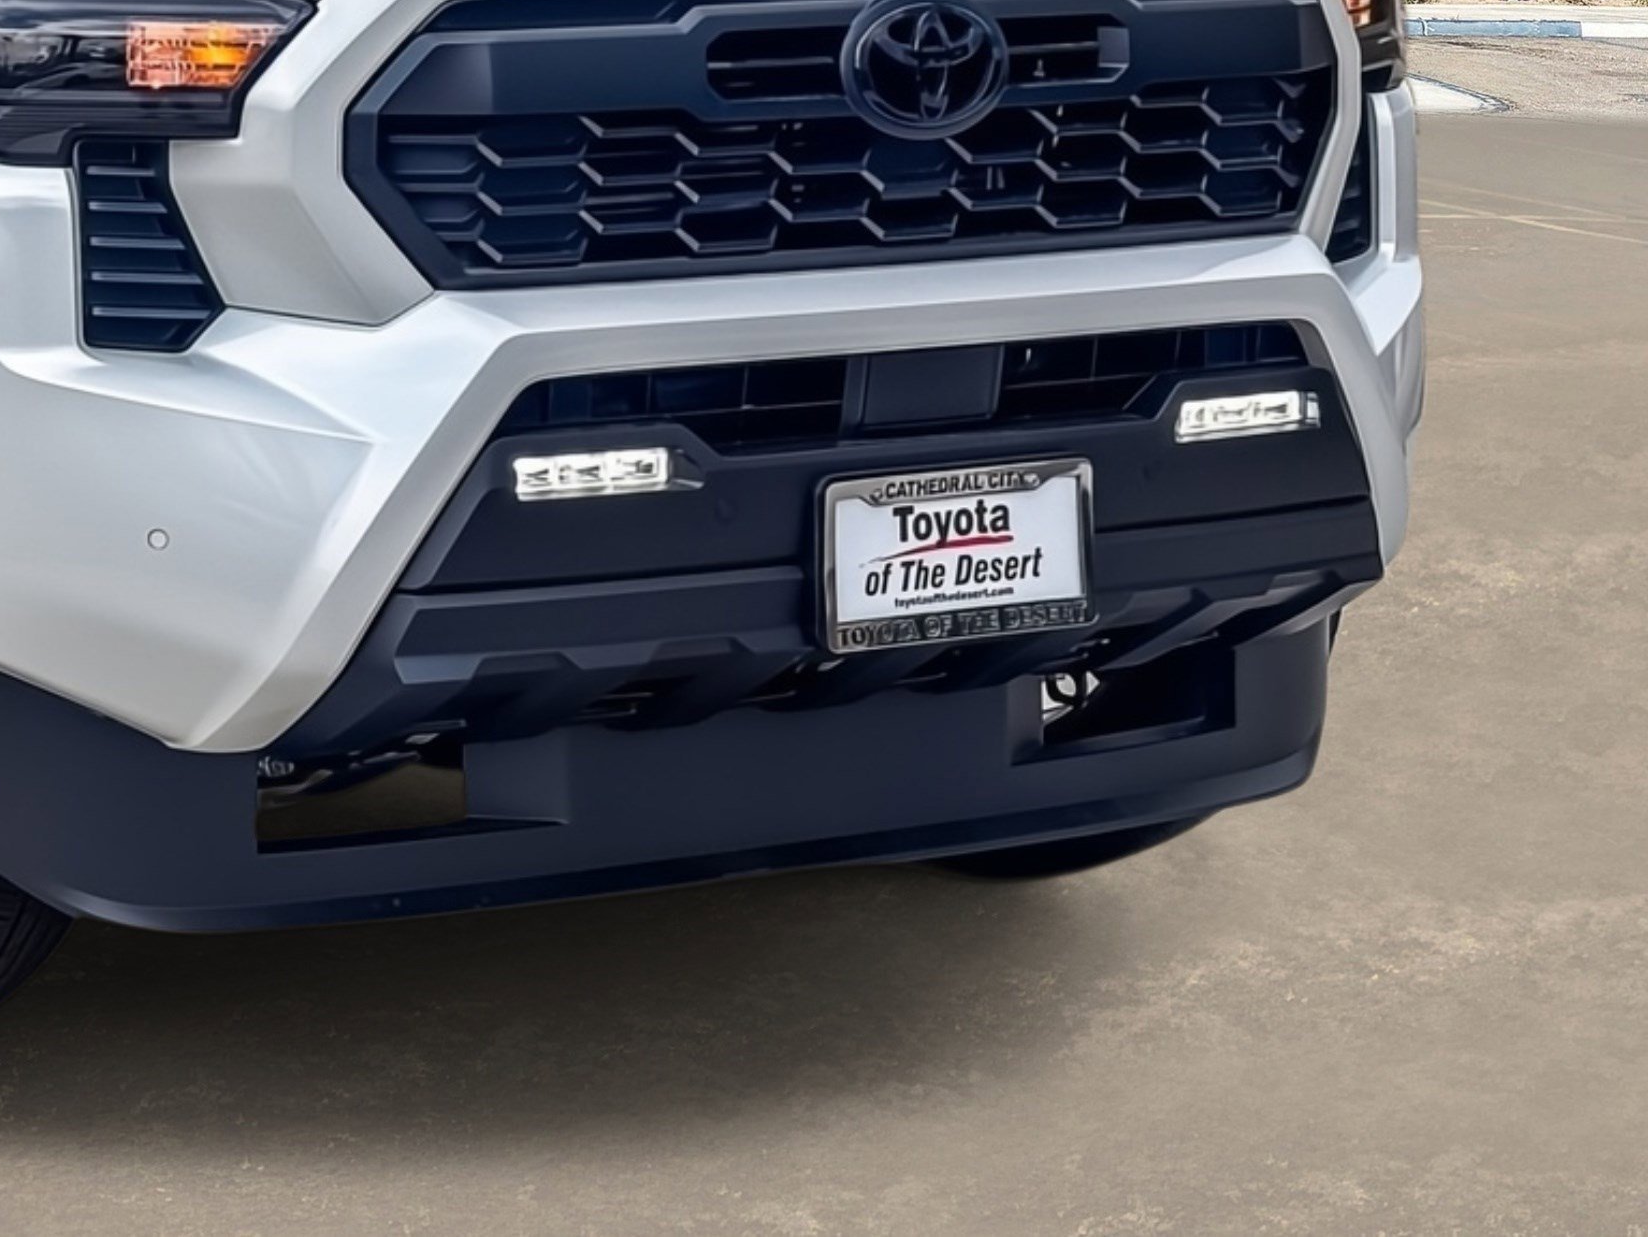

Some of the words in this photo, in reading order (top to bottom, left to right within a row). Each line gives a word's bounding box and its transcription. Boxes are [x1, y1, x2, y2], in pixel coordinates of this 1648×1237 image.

[884, 474, 983, 499] CATHEDRAL
[988, 471, 1026, 489] CITY
[892, 499, 1010, 546] Toyota
[864, 562, 892, 596] of
[901, 559, 945, 592] The
[955, 547, 1042, 587] Desert
[838, 619, 922, 647] TOYOTA
